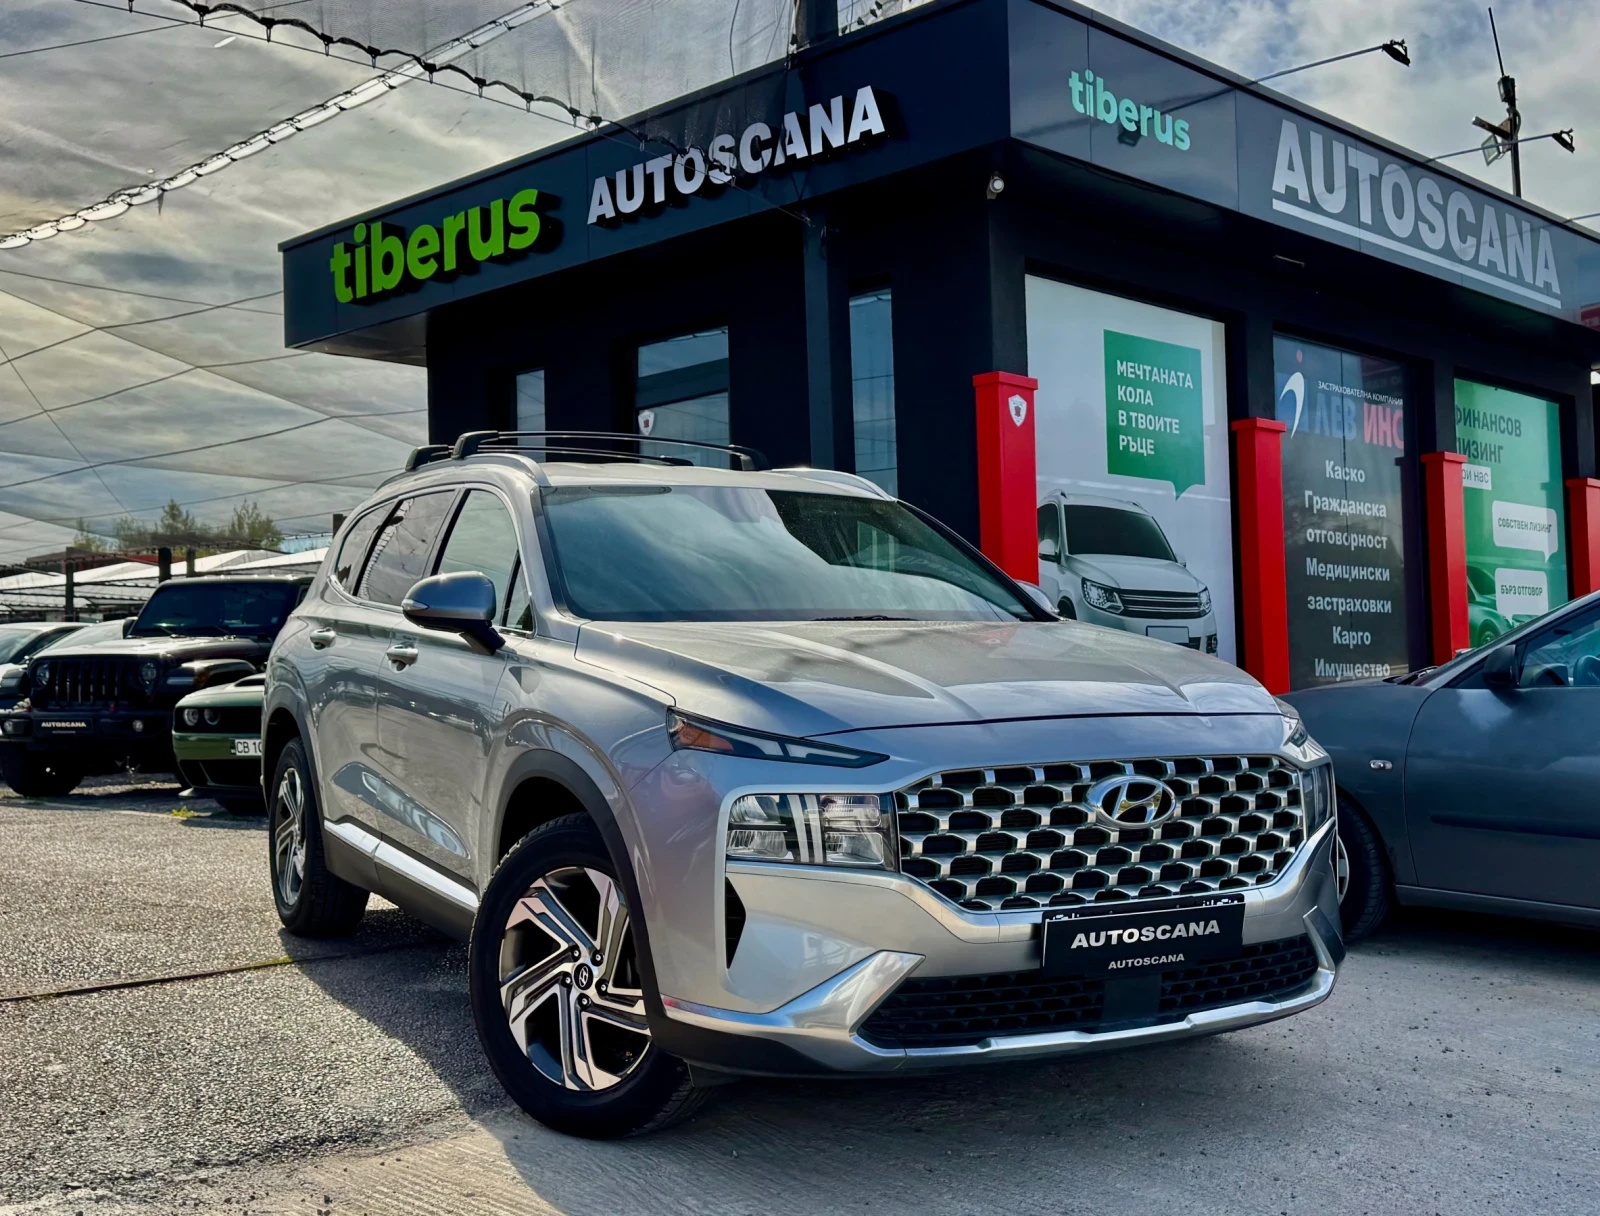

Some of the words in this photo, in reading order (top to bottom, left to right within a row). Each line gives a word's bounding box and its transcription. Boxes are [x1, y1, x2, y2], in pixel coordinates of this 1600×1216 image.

[1069, 70, 1191, 151] tiberus
[587, 85, 886, 225] AUTOSCANA
[1272, 119, 1561, 296] AUTOSCANA
[330, 189, 541, 303] tiberus
[1116, 360, 1194, 389] МЕЧТАНАТА
[1117, 385, 1154, 406] КОЛА
[1118, 409, 1127, 426] В
[1129, 411, 1180, 434] ТВОИТЕ
[1119, 434, 1155, 457] РЪЦЕ
[1325, 459, 1366, 483] Каско
[1473, 470, 1489, 483] нас
[1305, 490, 1387, 518] Гражданска
[1497, 518, 1529, 531] СОБСТВЕН
[1306, 528, 1388, 551] отговорност
[1306, 557, 1391, 582] Медицински
[1501, 585, 1517, 595] БЪРЗ
[1517, 586, 1543, 596] ОТГОВОР
[1307, 595, 1392, 616] застраховки
[1332, 626, 1372, 650] Карго
[1315, 658, 1391, 682] Имущество
[1070, 919, 1221, 949] AUTOSCANA
[1108, 953, 1185, 970] AUTOSCANA
